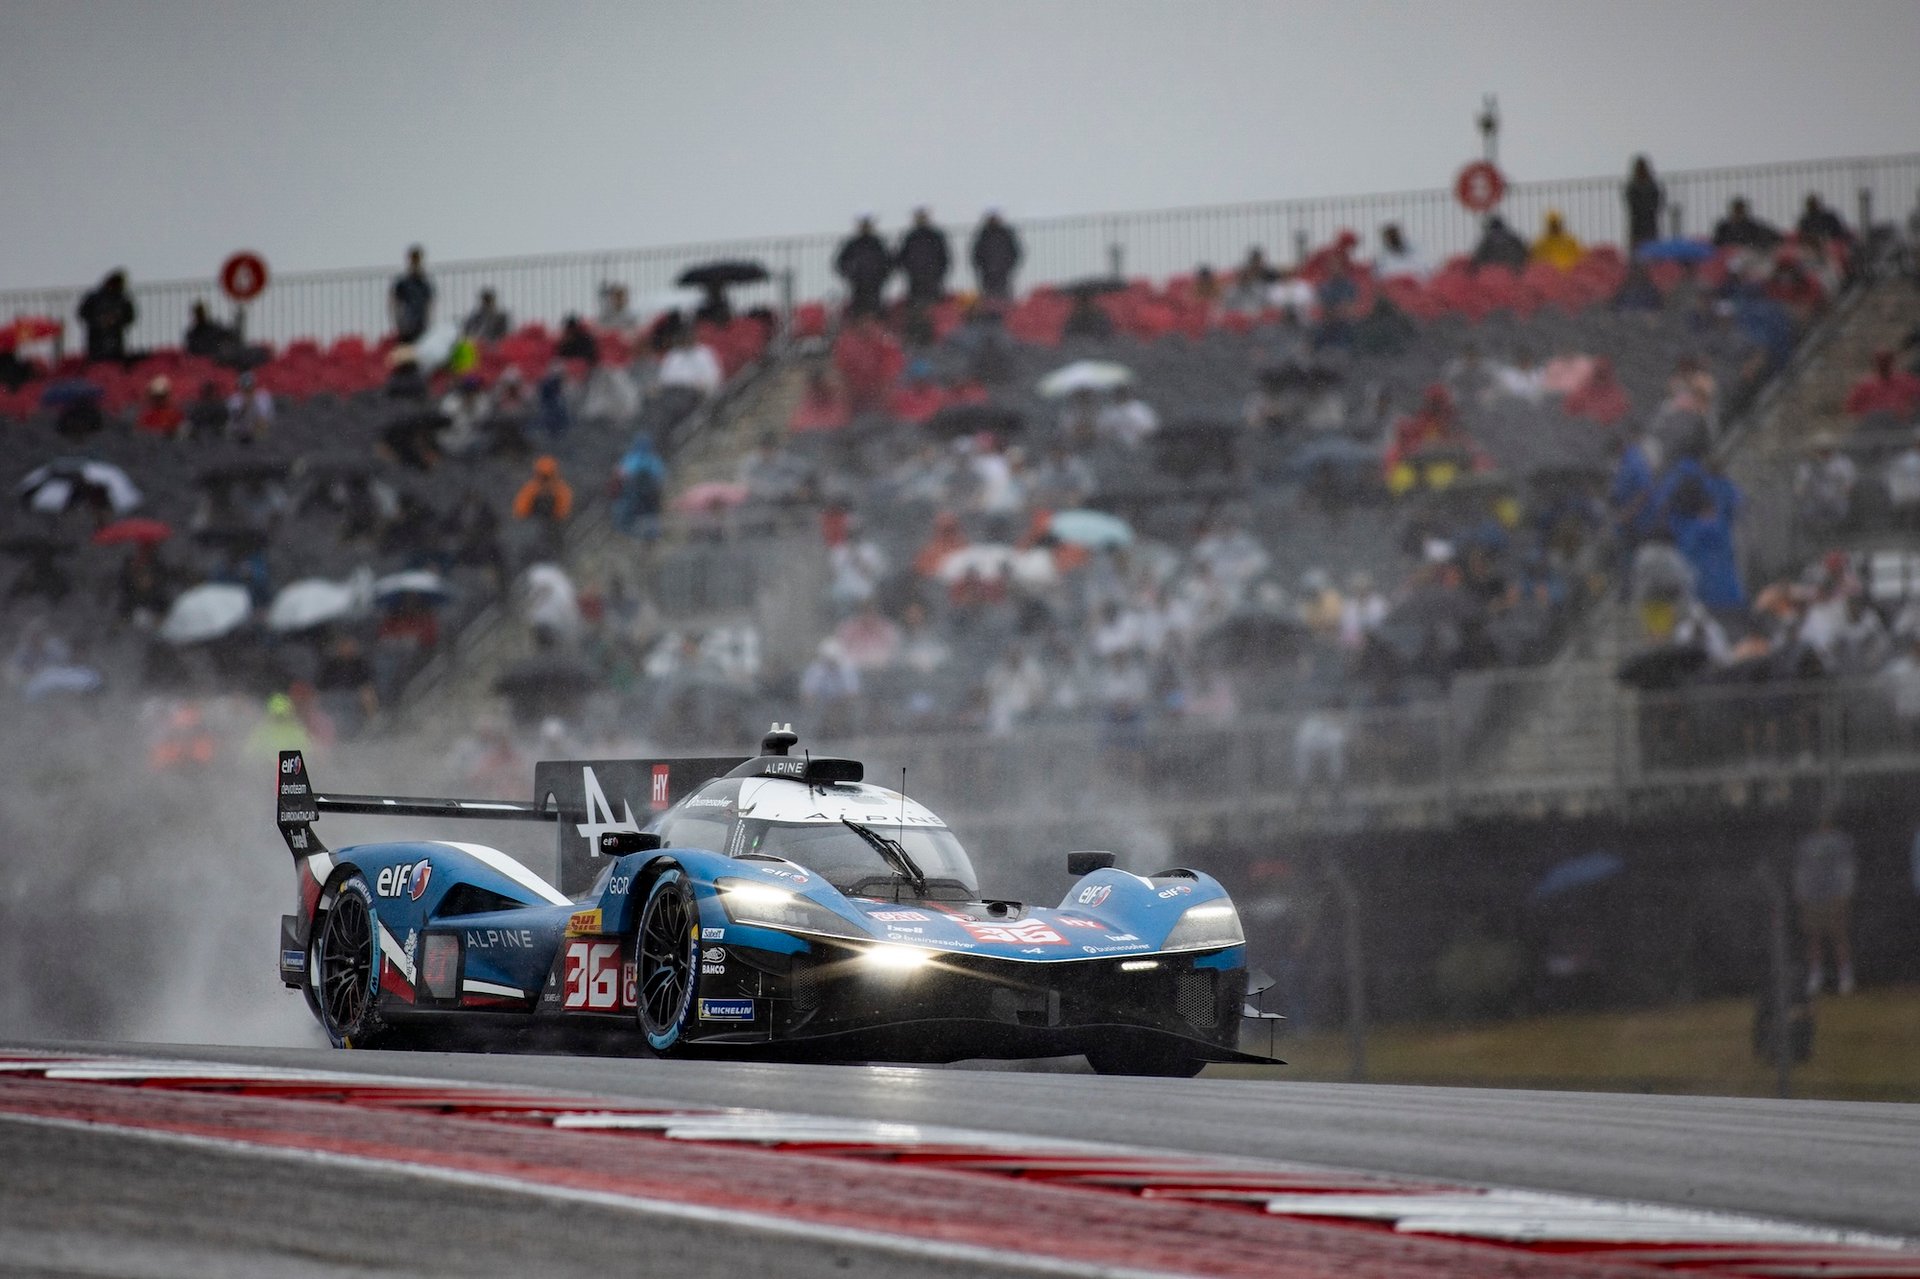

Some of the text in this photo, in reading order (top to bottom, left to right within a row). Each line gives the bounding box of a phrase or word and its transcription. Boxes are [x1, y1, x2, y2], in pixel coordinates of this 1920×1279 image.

[281, 758, 294, 773] elf
[765, 762, 804, 773] ALPINE
[281, 782, 306, 794] devoteam
[653, 774, 668, 801] HY
[804, 812, 945, 825] ALPINE
[761, 867, 791, 878] elf
[377, 864, 411, 897] elf
[609, 876, 629, 895] GCR
[1078, 885, 1102, 904] elf
[1158, 888, 1179, 899] elf
[571, 915, 598, 930] DHL
[467, 930, 534, 948] ALPINE
[965, 924, 1063, 943] 36
[904, 934, 976, 949] businessolver
[1094, 943, 1150, 953] businessolver
[564, 943, 619, 1008] 36
[702, 965, 725, 975] BAHCO
[679, 955, 697, 1025] MICHELIN
[711, 1006, 752, 1014] MICHELIN
